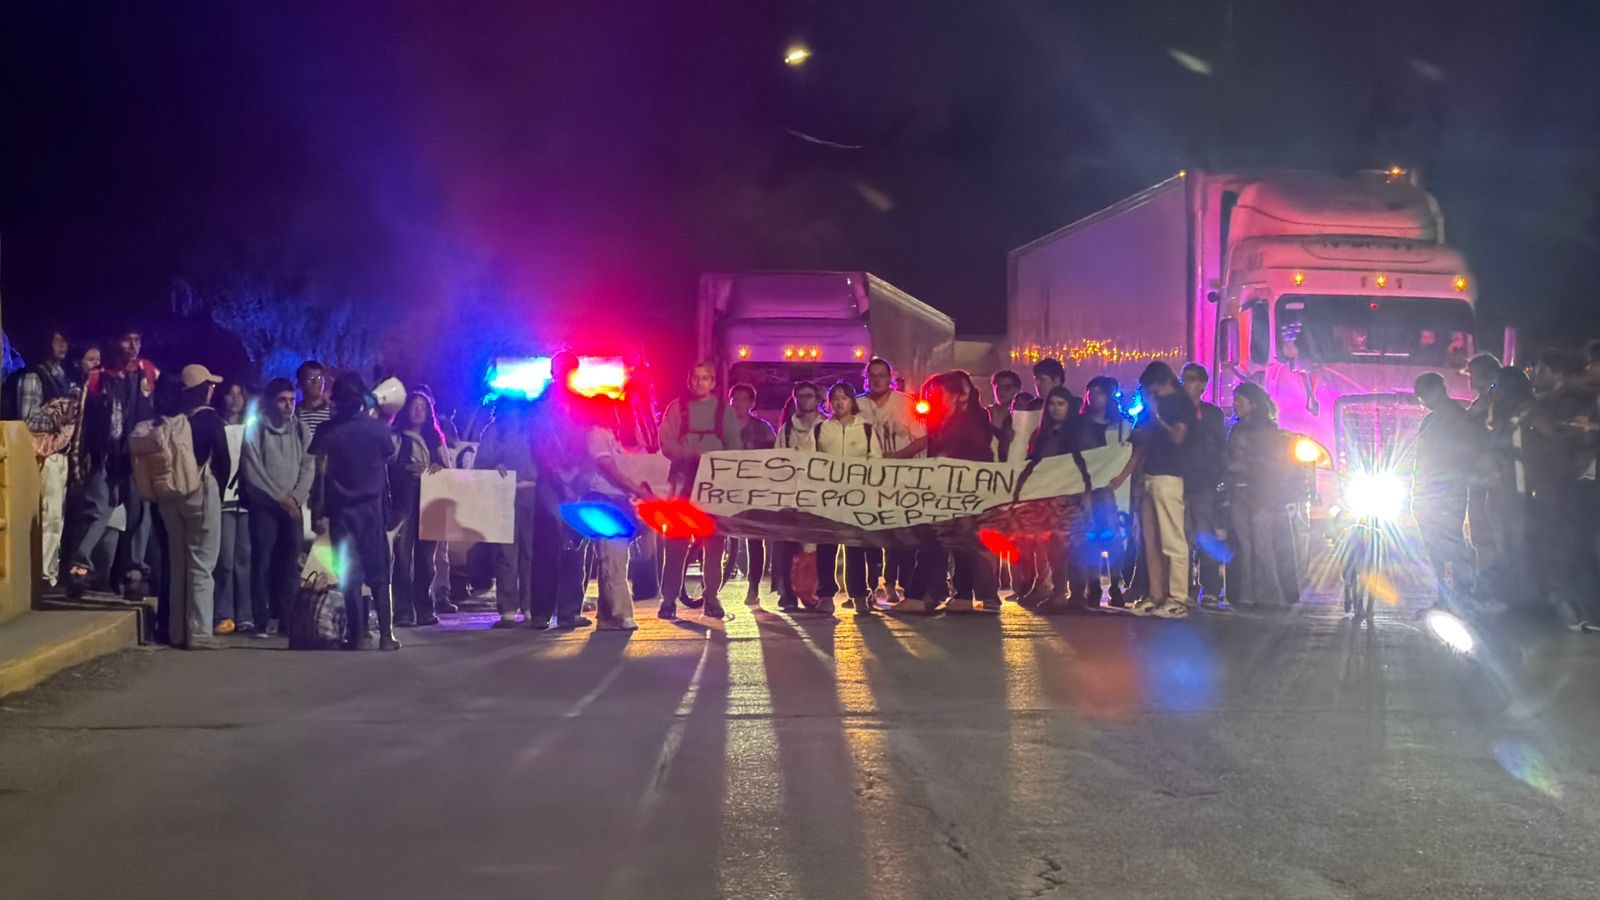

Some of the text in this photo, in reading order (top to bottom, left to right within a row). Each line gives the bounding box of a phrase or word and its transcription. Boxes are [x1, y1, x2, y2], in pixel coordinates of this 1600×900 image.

[697, 482, 984, 511] PREFIERO MORIR
[853, 510, 896, 526] DE
